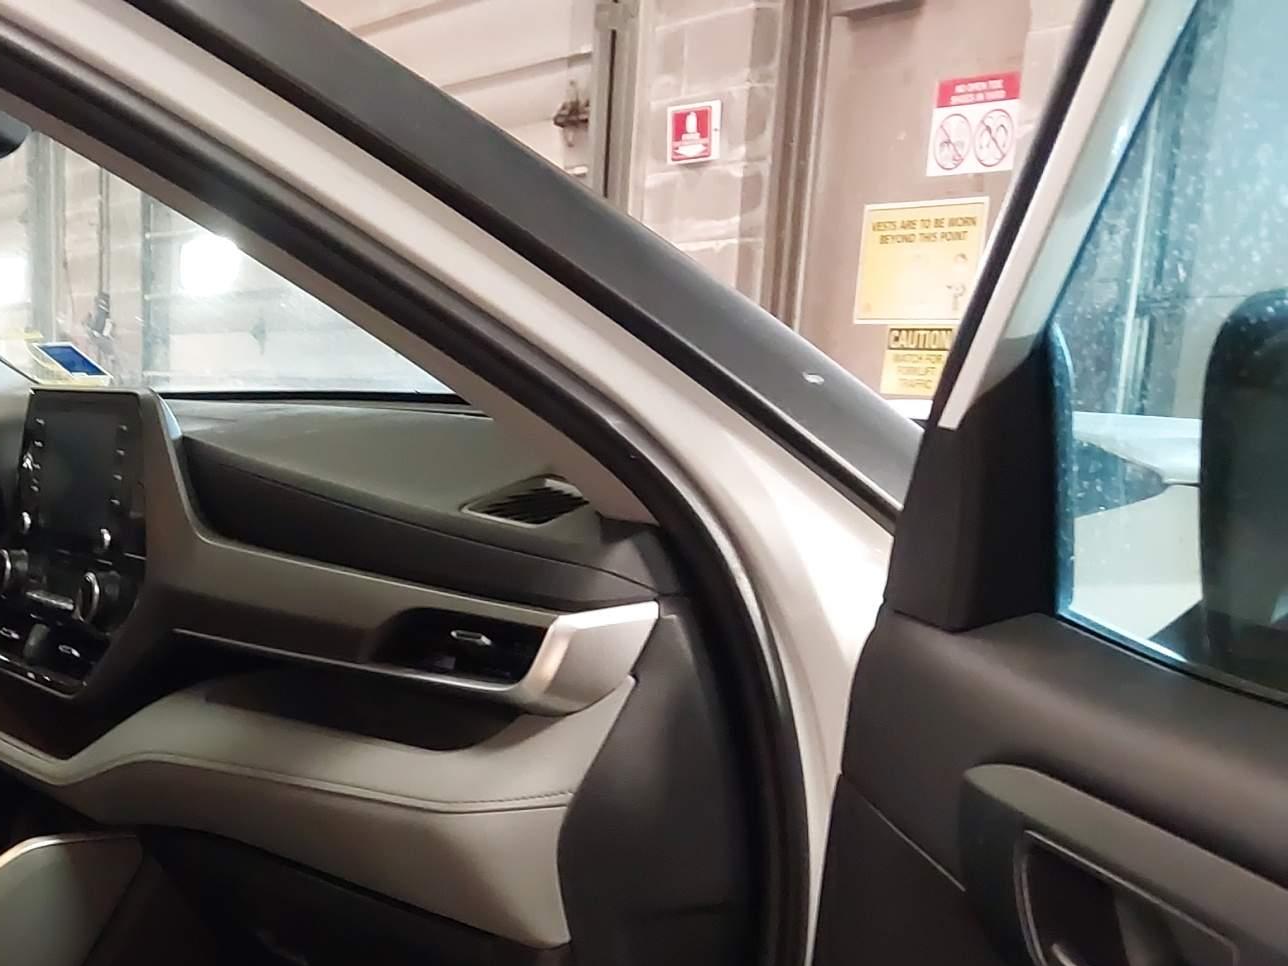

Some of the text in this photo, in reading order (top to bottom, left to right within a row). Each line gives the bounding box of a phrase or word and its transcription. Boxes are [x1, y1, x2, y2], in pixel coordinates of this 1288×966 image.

[872, 216, 977, 232] VESTS ARE TO BE WORN
[880, 230, 968, 244] BEYOND THIS POINT
[890, 329, 951, 349] CAUTION
